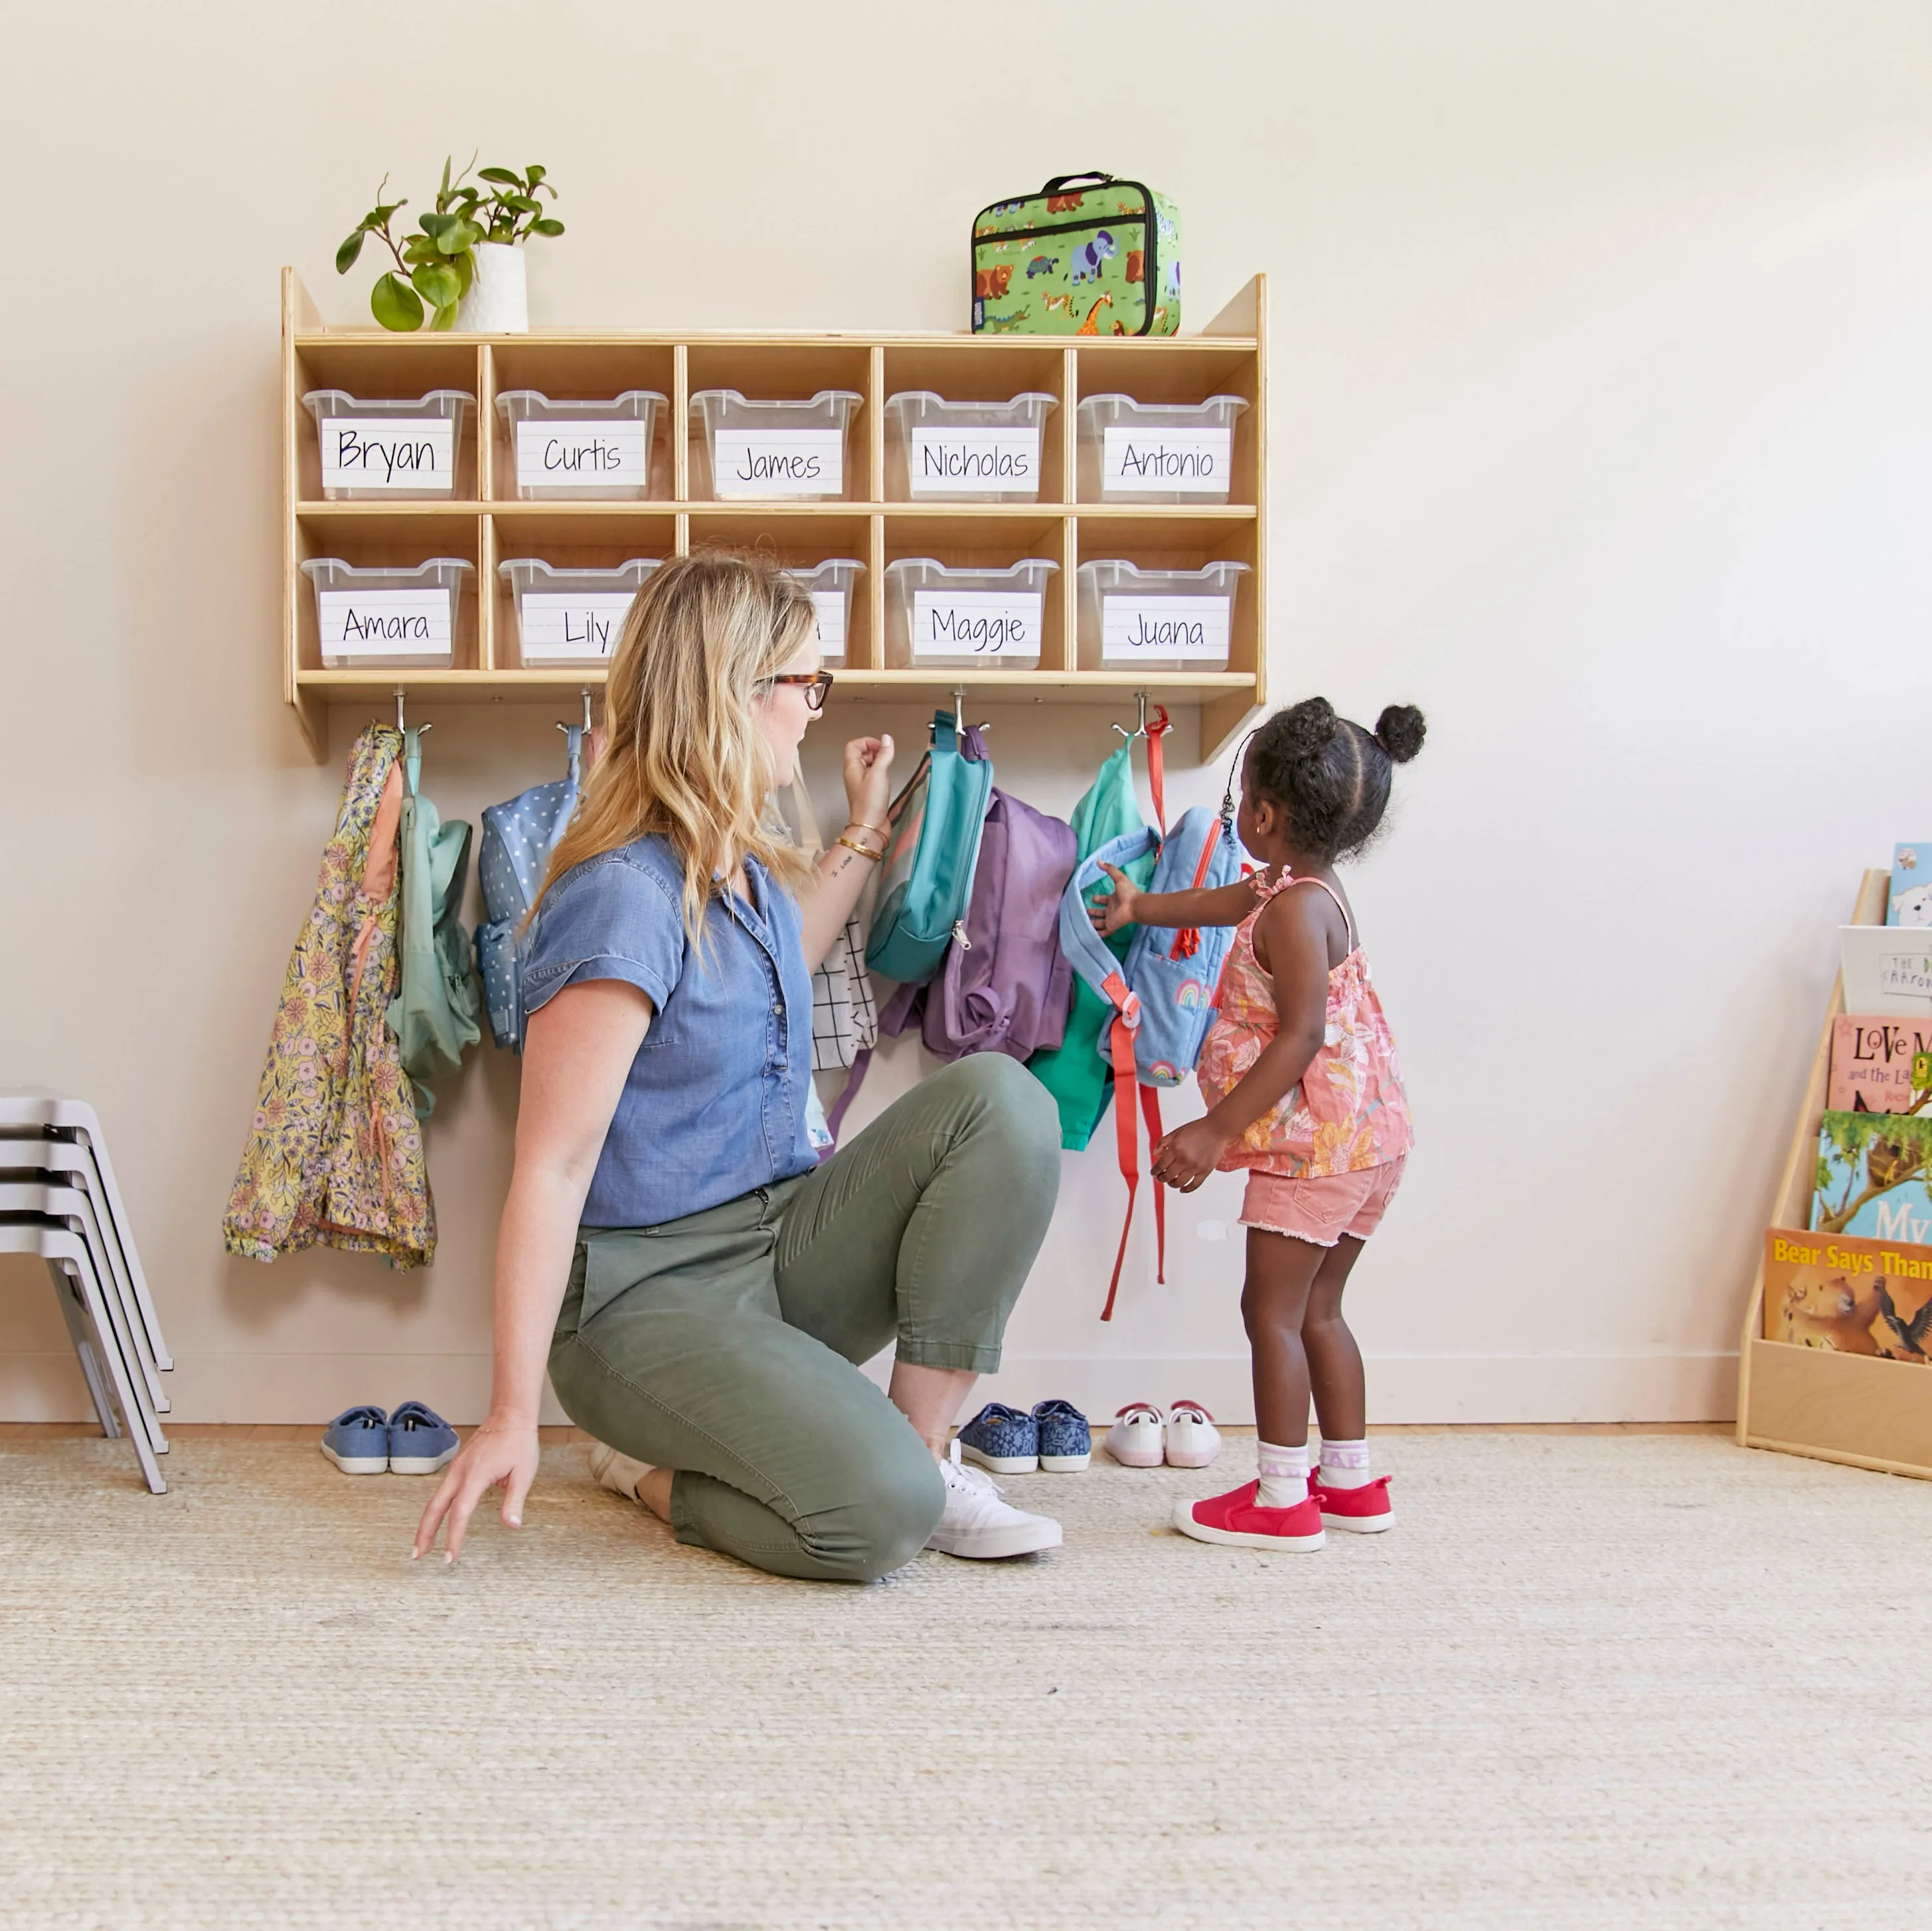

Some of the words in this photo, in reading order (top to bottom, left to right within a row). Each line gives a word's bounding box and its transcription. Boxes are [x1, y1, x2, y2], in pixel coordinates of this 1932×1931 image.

[339, 431, 434, 483] Bryan
[544, 439, 621, 471] Curtis
[736, 447, 821, 481] James
[924, 445, 1028, 477] Nicholas
[1121, 444, 1214, 477] Antonio
[343, 609, 430, 641] Amara
[564, 611, 610, 654] Lily
[931, 609, 1026, 652] Maggie
[1128, 613, 1204, 646] Juana
[1871, 1067, 1890, 1083] the
[1774, 1237, 1822, 1266] Bear
[1826, 1245, 1874, 1277] Says
